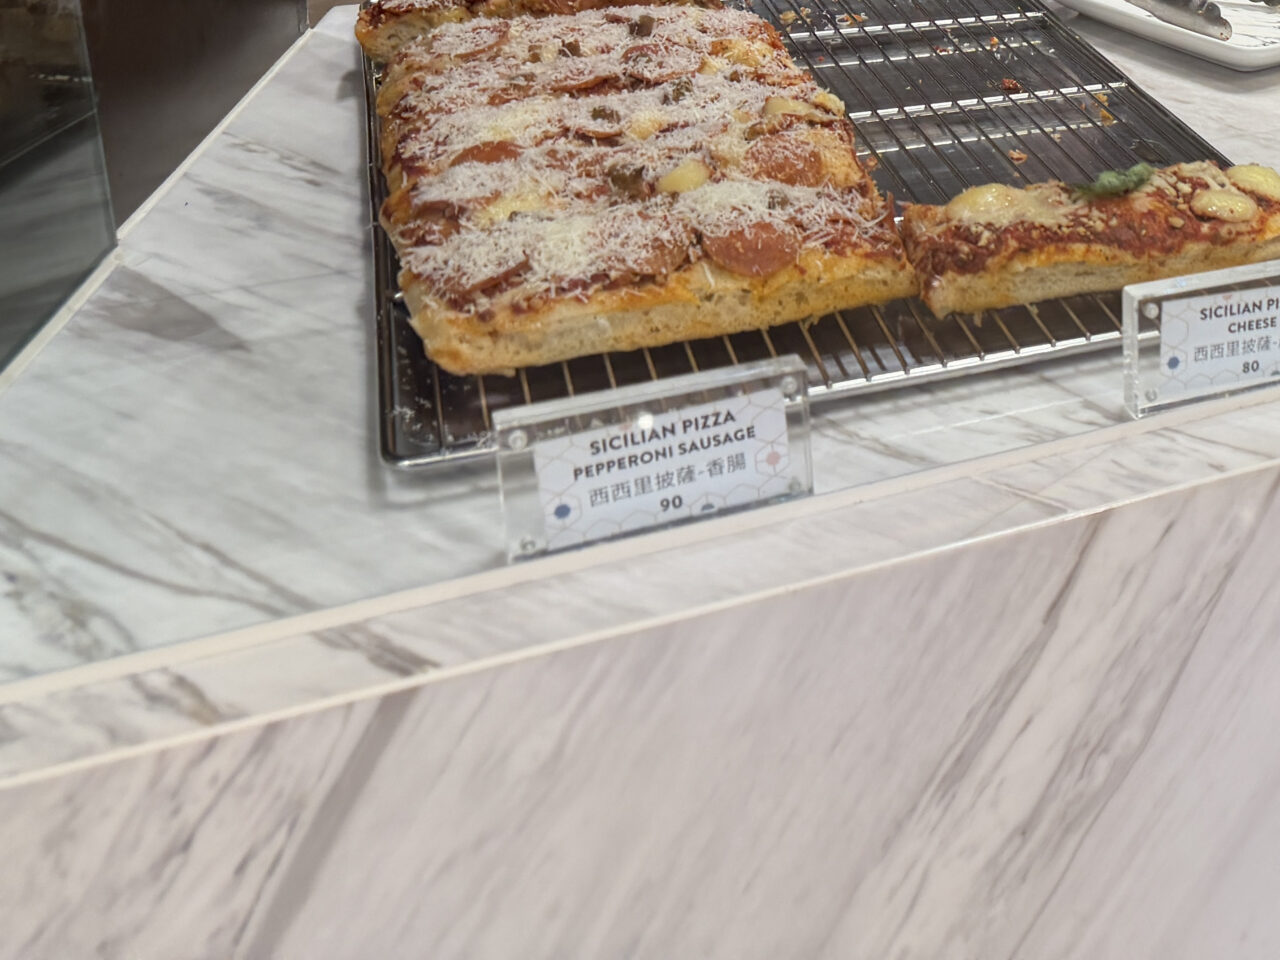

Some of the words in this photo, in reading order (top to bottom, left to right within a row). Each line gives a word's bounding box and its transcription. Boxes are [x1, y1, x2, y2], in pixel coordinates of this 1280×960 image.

[1200, 300, 1263, 321] SICILIAN
[1228, 316, 1277, 334] CHEESE
[1242, 360, 1260, 373] 80
[589, 422, 676, 455] SICILIAN
[683, 410, 736, 436] PIZZA
[573, 447, 674, 481] PEPPERONI
[678, 425, 756, 456] SAUSAGE
[660, 495, 683, 512] 90
